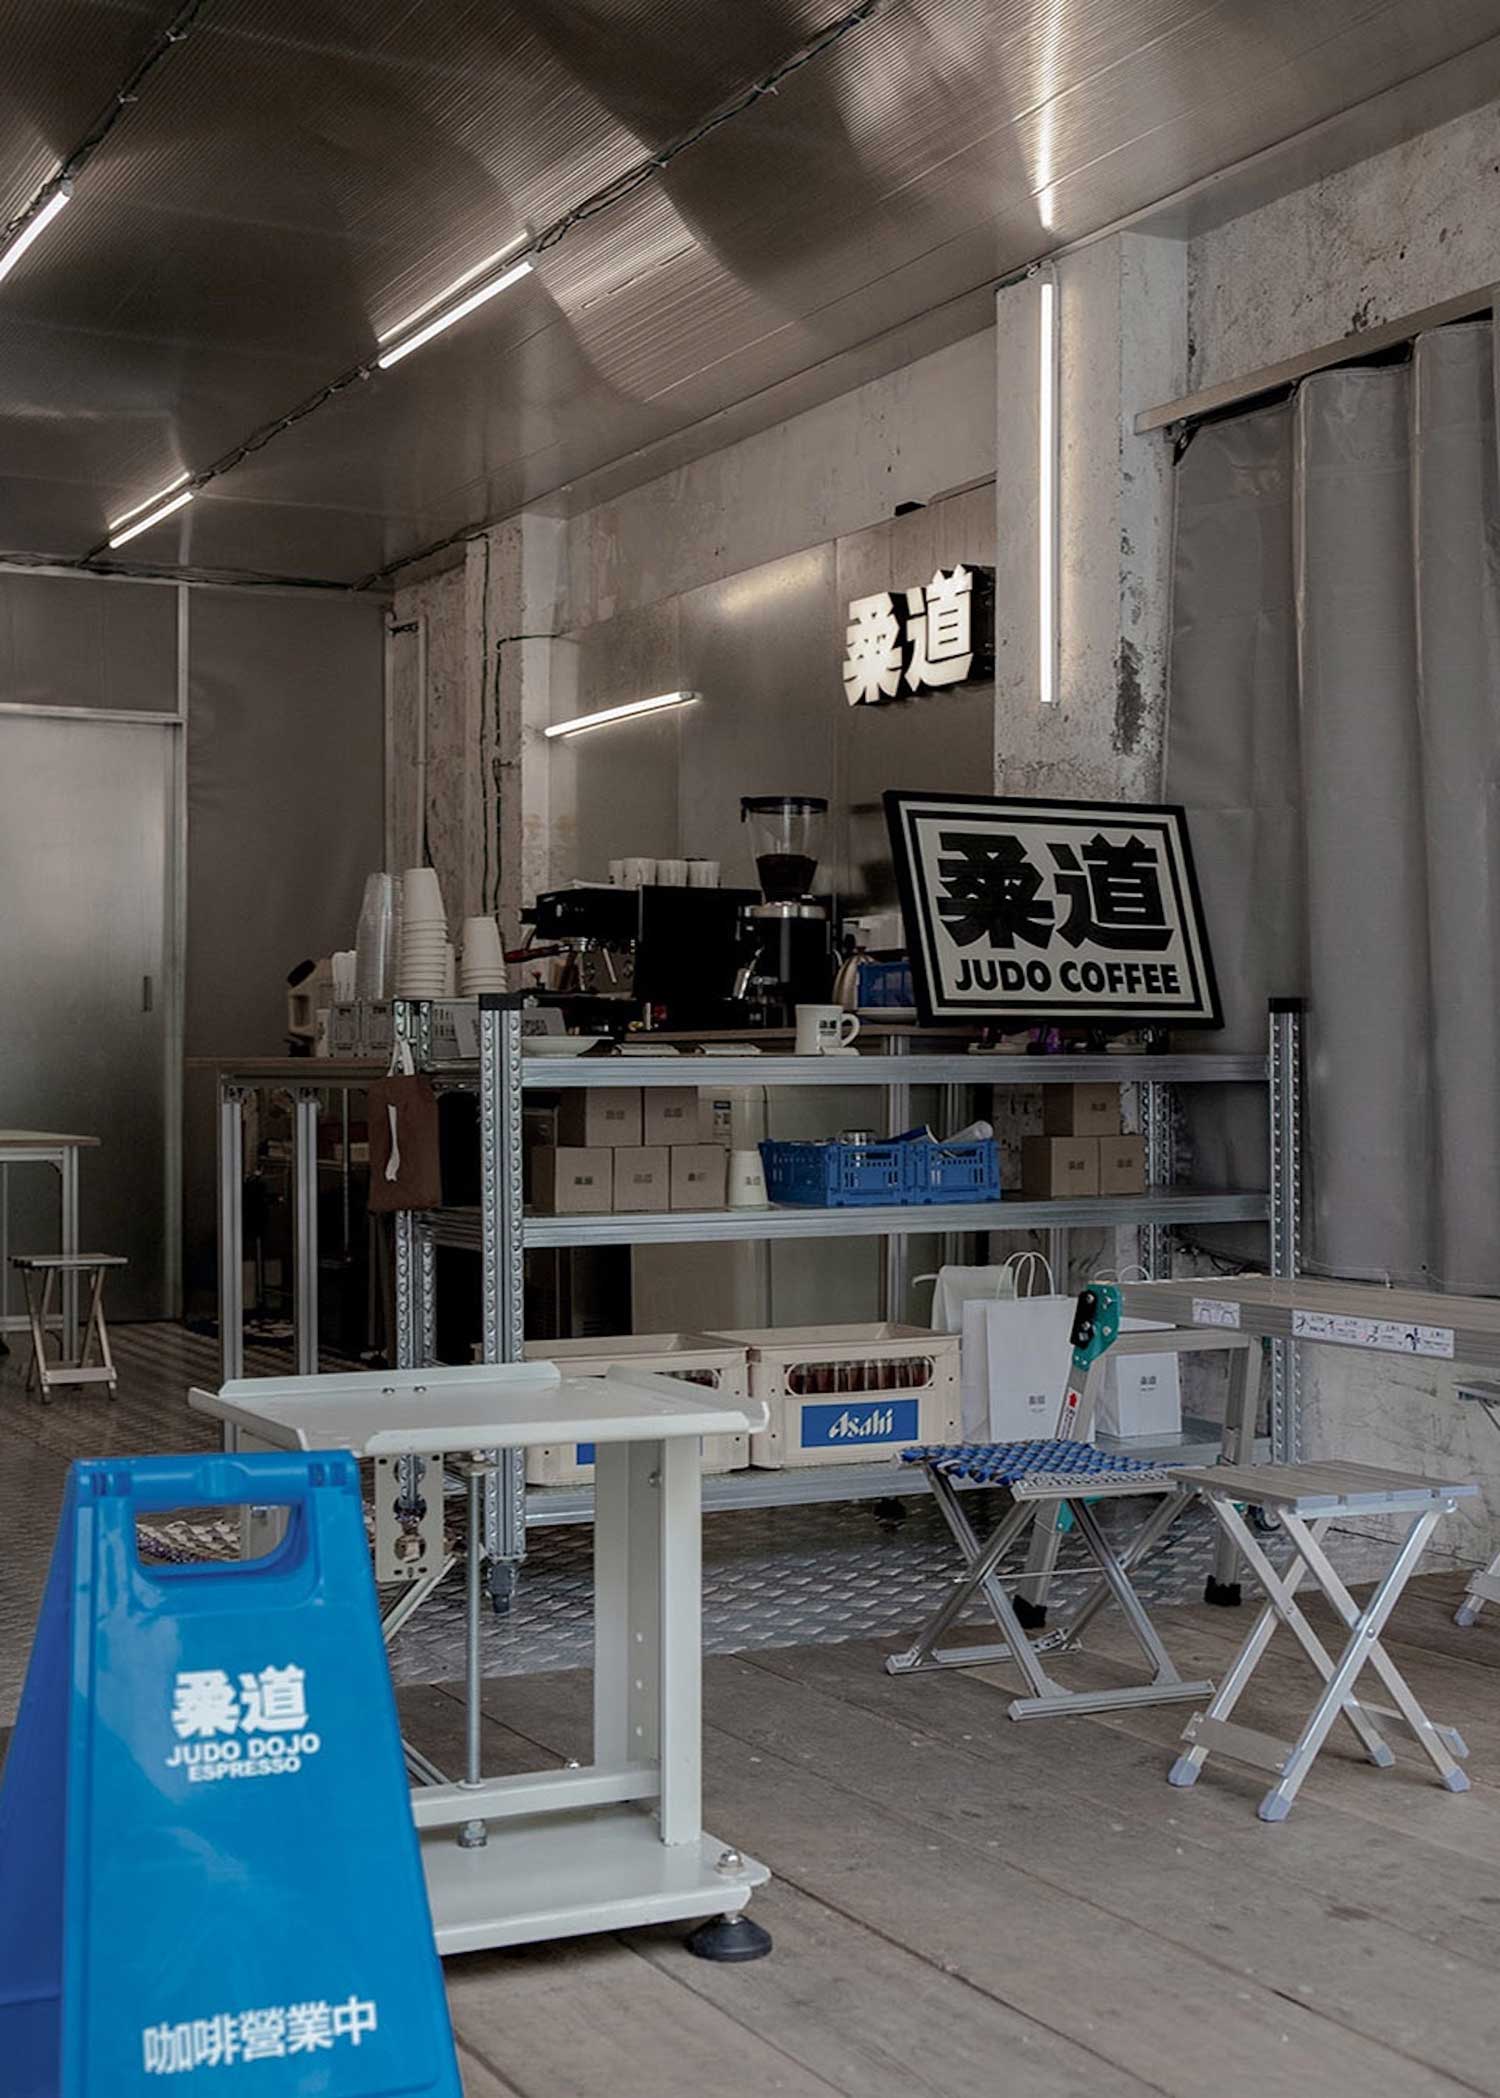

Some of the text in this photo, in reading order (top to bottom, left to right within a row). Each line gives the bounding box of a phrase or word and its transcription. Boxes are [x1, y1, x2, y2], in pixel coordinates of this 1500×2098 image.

[843, 564, 974, 706] 柔道
[936, 832, 1176, 953] 柔道
[955, 959, 1181, 994] JUDO COFFEE
[828, 1408, 894, 1438] Asahi
[171, 1664, 310, 1738] 柔道
[166, 1733, 320, 1767] JUDO DOJO
[188, 1757, 302, 1782] ESPRESSO
[141, 1994, 379, 2076] 咖啡營業中
